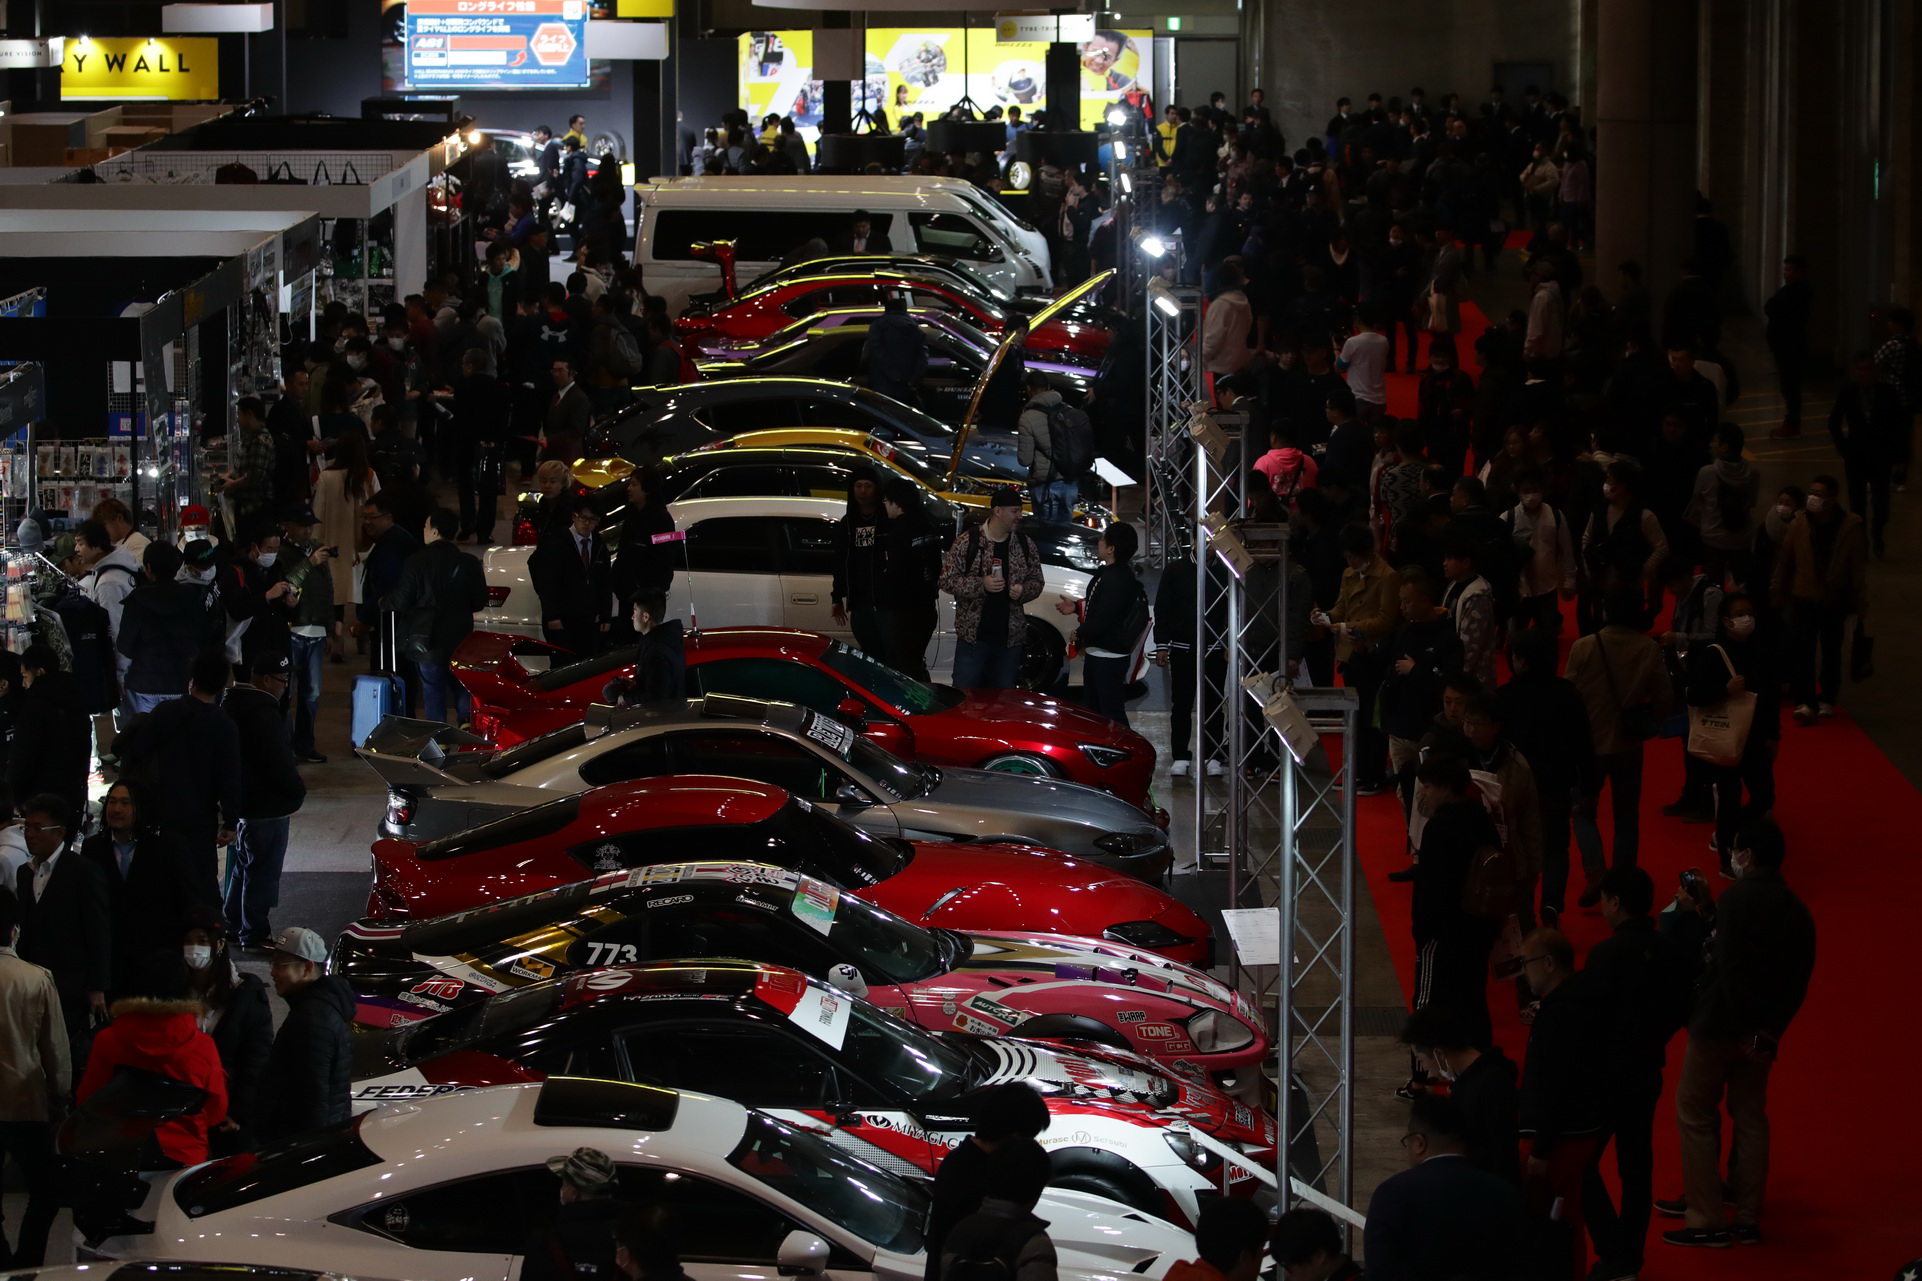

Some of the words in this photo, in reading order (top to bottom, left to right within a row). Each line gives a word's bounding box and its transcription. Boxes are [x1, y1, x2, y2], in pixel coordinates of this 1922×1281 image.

[104, 53, 190, 73] WALL
[1709, 720, 1730, 728] TEIN
[646, 894, 695, 909] RECARO
[585, 941, 638, 967] 773
[410, 975, 465, 1000] JTB
[1138, 1026, 1174, 1037] TONE
[1166, 1042, 1190, 1051] GCG
[892, 1121, 944, 1147] MIYAGI
